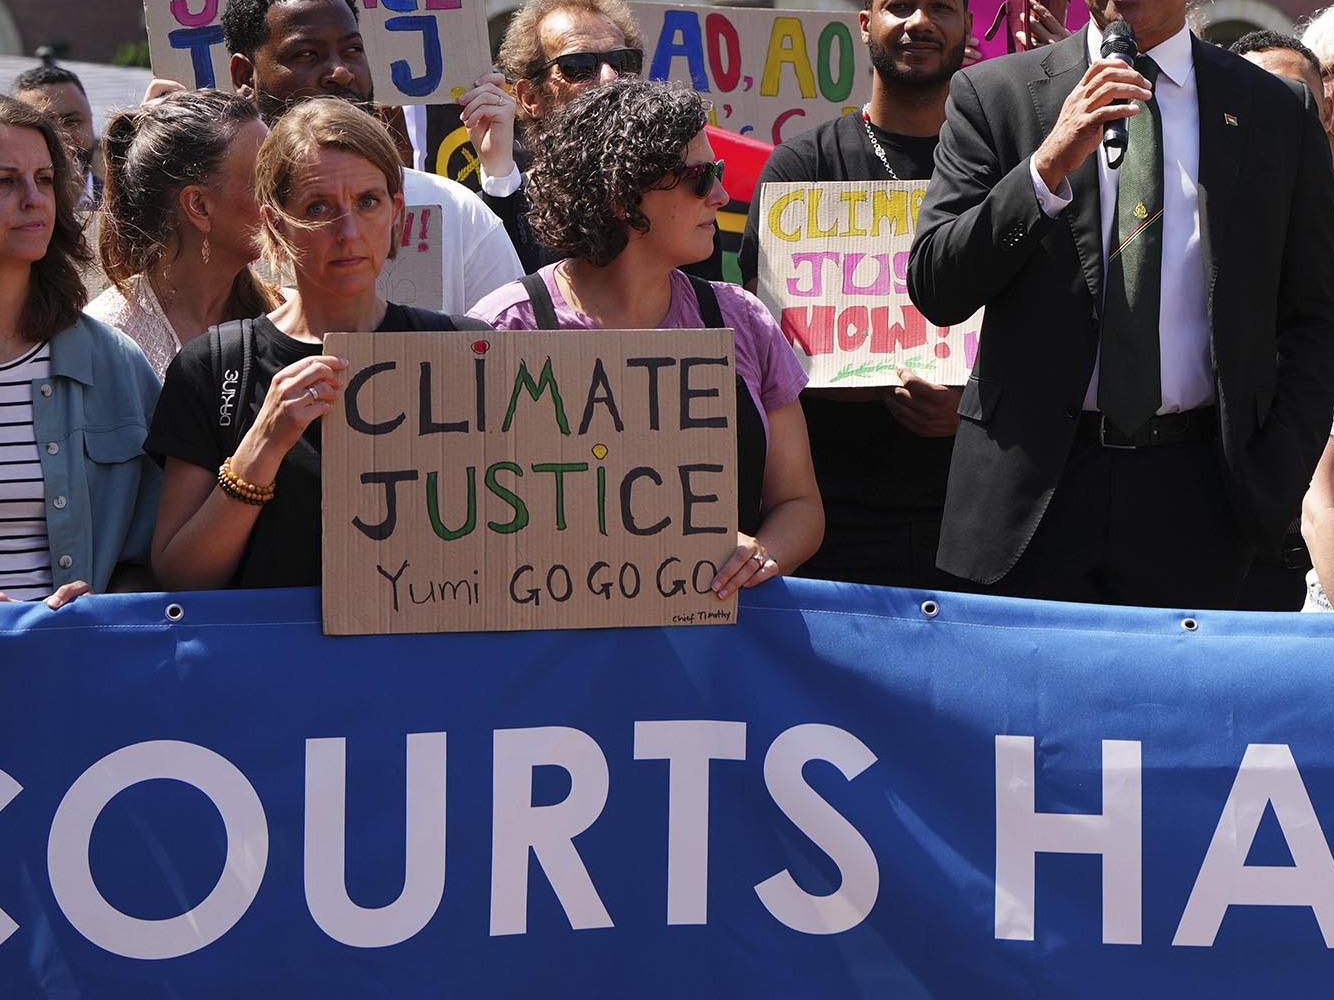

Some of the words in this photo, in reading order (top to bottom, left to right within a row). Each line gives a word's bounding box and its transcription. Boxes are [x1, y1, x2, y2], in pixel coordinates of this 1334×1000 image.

[760, 17, 854, 102] AO
[377, 560, 480, 612] Yumi
[509, 561, 573, 606] GO
[587, 561, 641, 599] GO
[656, 557, 718, 598] GO
[0, 720, 879, 959] OURTS
